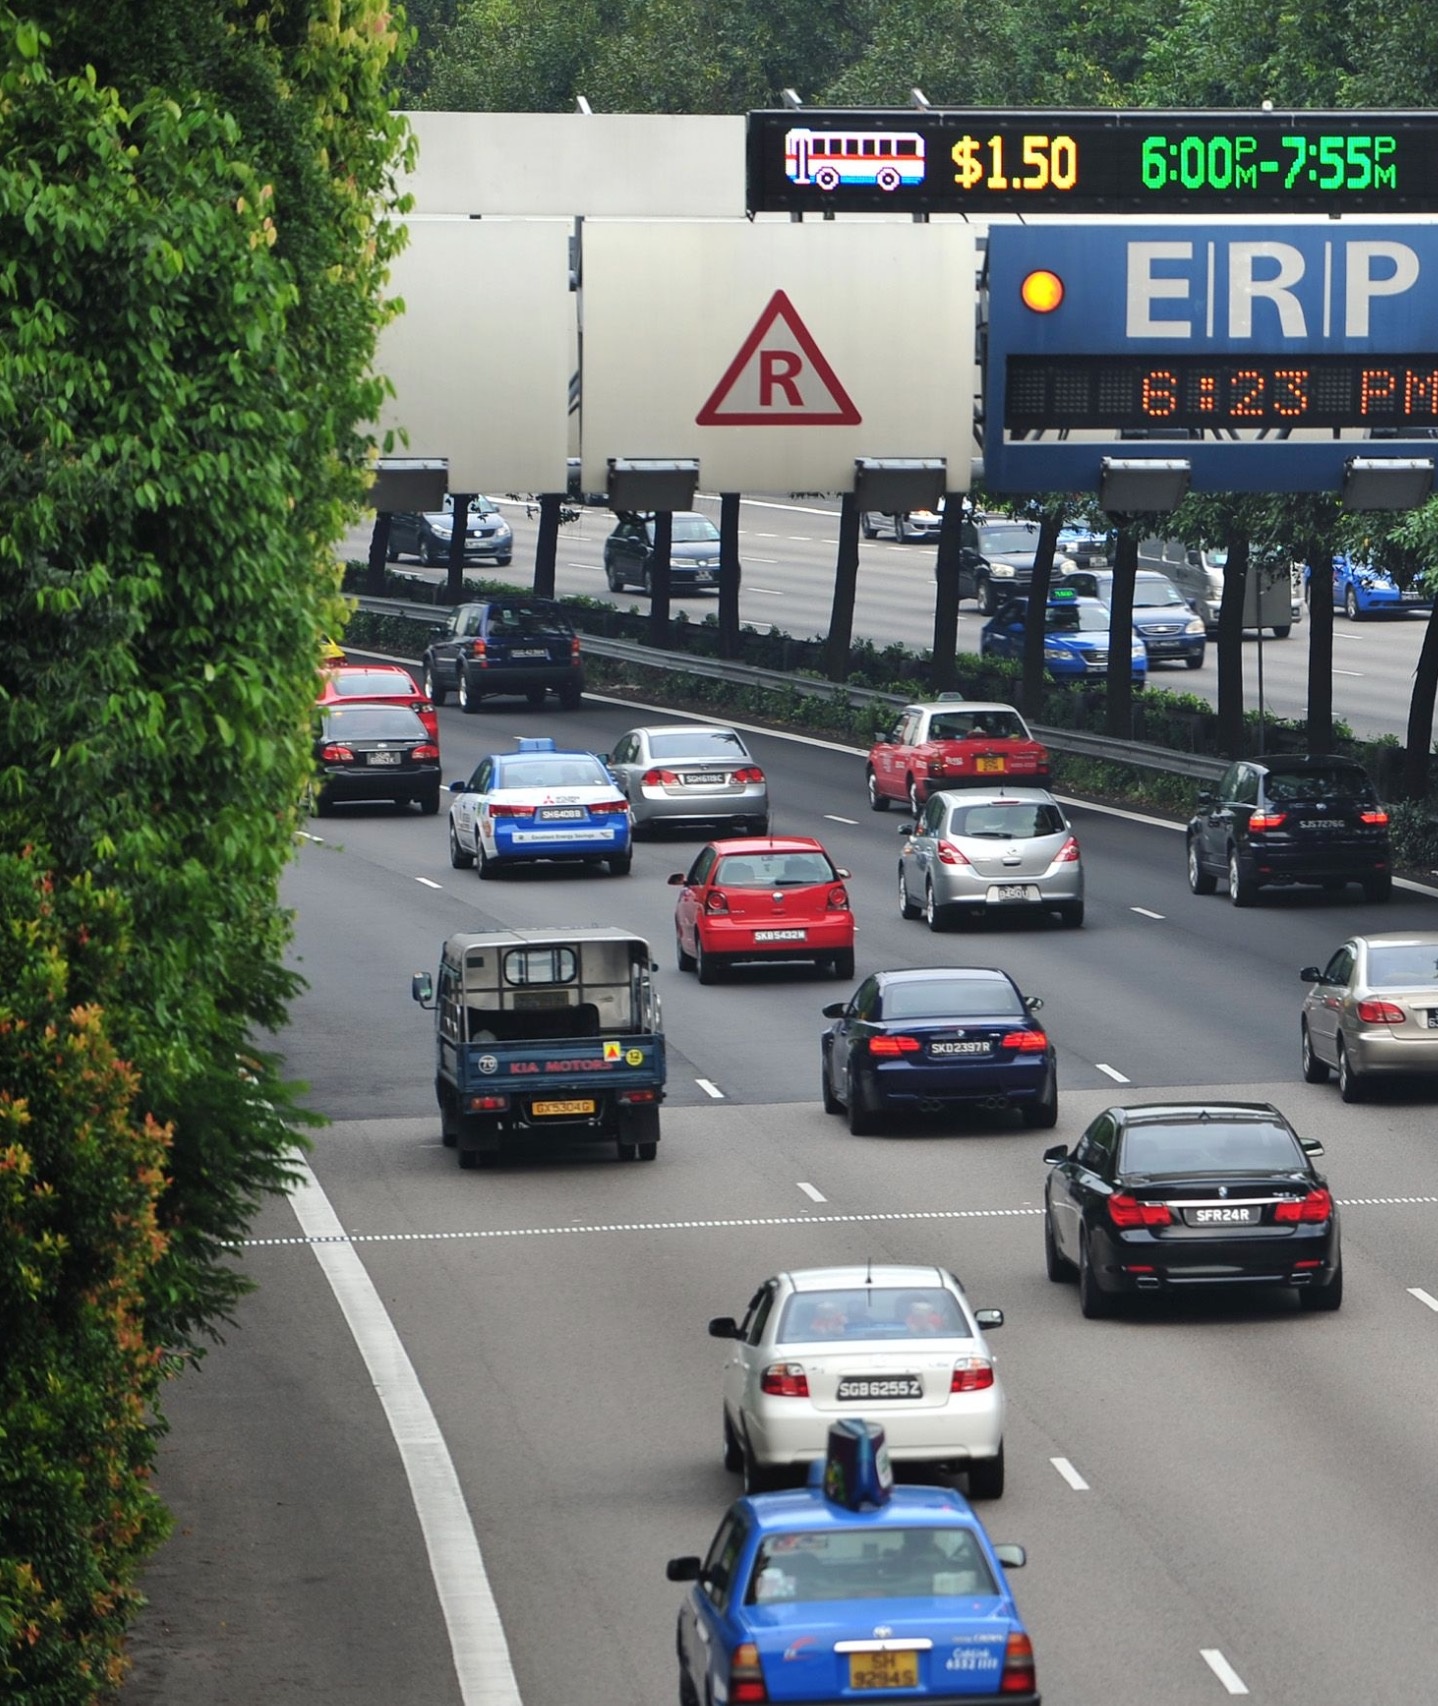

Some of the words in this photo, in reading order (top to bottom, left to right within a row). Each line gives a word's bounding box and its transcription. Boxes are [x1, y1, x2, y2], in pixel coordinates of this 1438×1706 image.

[951, 135, 1076, 189] $1.50
[759, 350, 804, 406] R
[1142, 371, 1308, 416] 6:23
[931, 1042, 990, 1054] SKD2397R
[510, 1062, 539, 1074] KIA
[546, 1059, 613, 1073] MOTORS
[536, 1102, 590, 1114] GX5304G
[1196, 1208, 1250, 1222] SFR24R
[839, 1381, 920, 1397] SGB6255Z
[871, 1655, 896, 1669] SH
